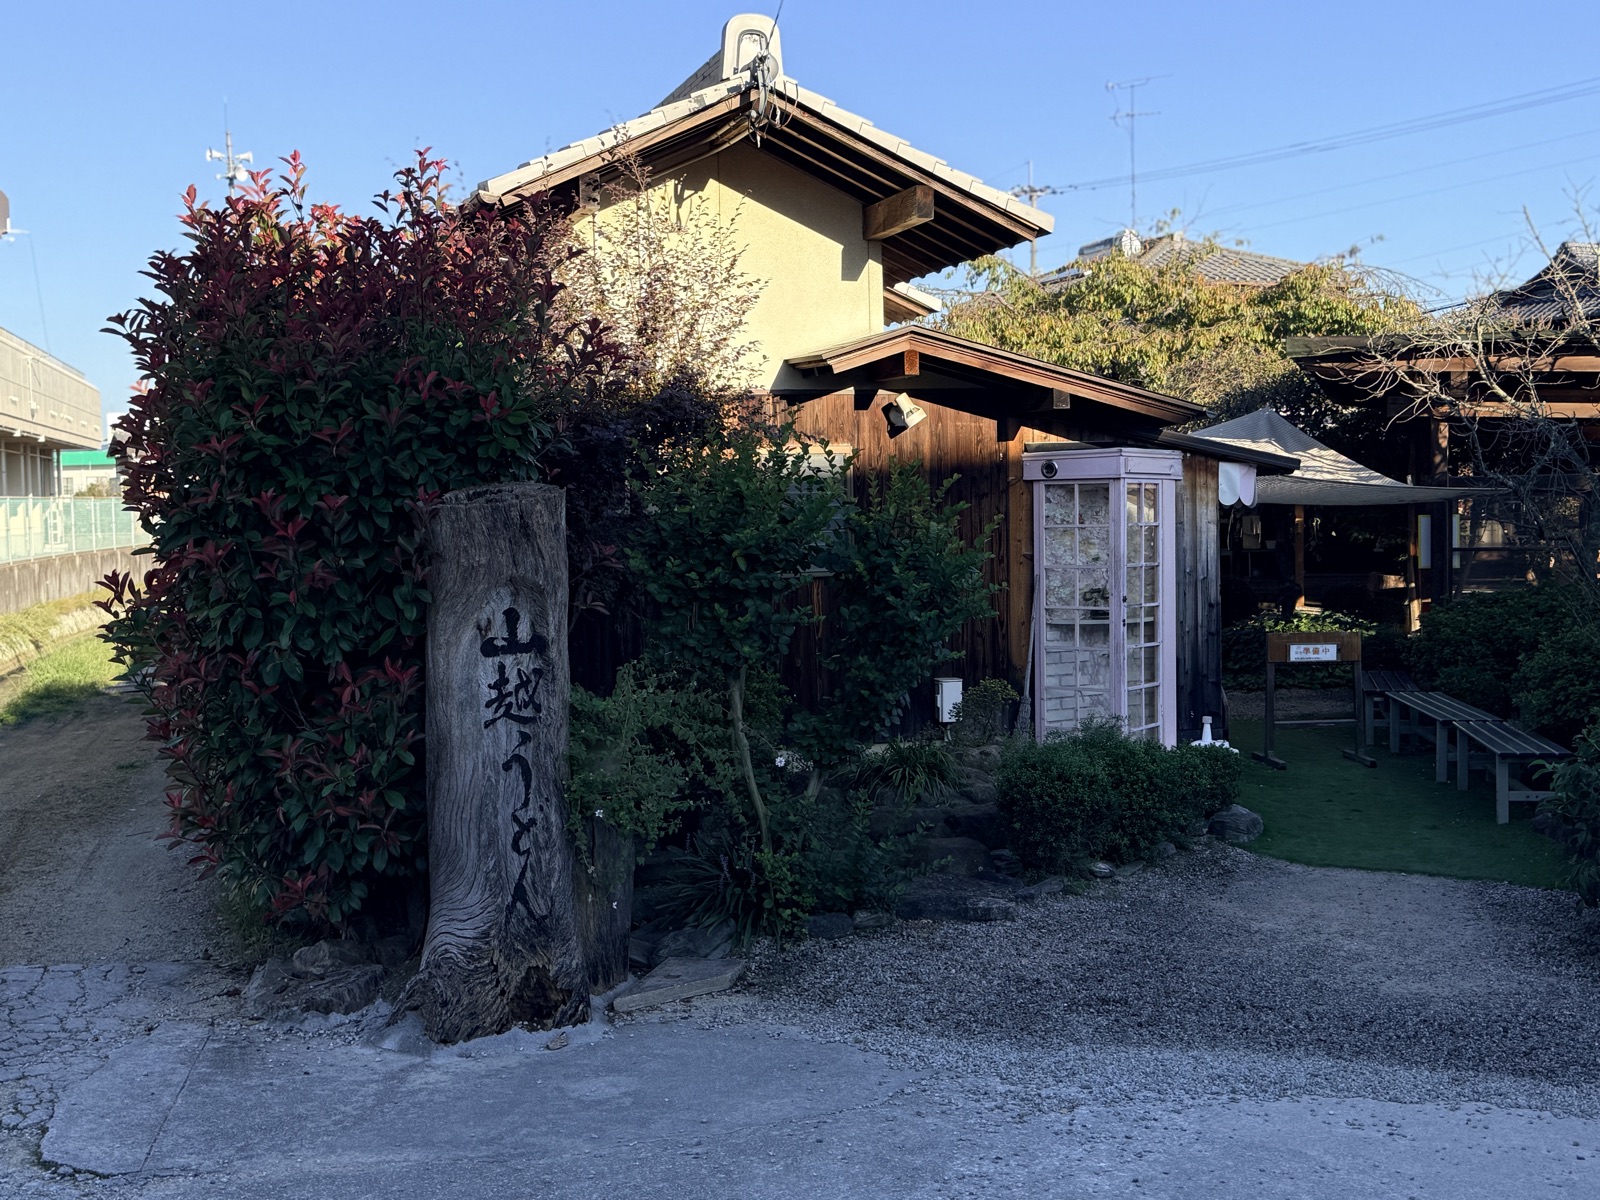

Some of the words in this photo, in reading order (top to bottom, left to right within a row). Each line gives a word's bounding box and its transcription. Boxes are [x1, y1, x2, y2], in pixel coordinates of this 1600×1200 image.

[480, 606, 548, 919] 山越うどん
